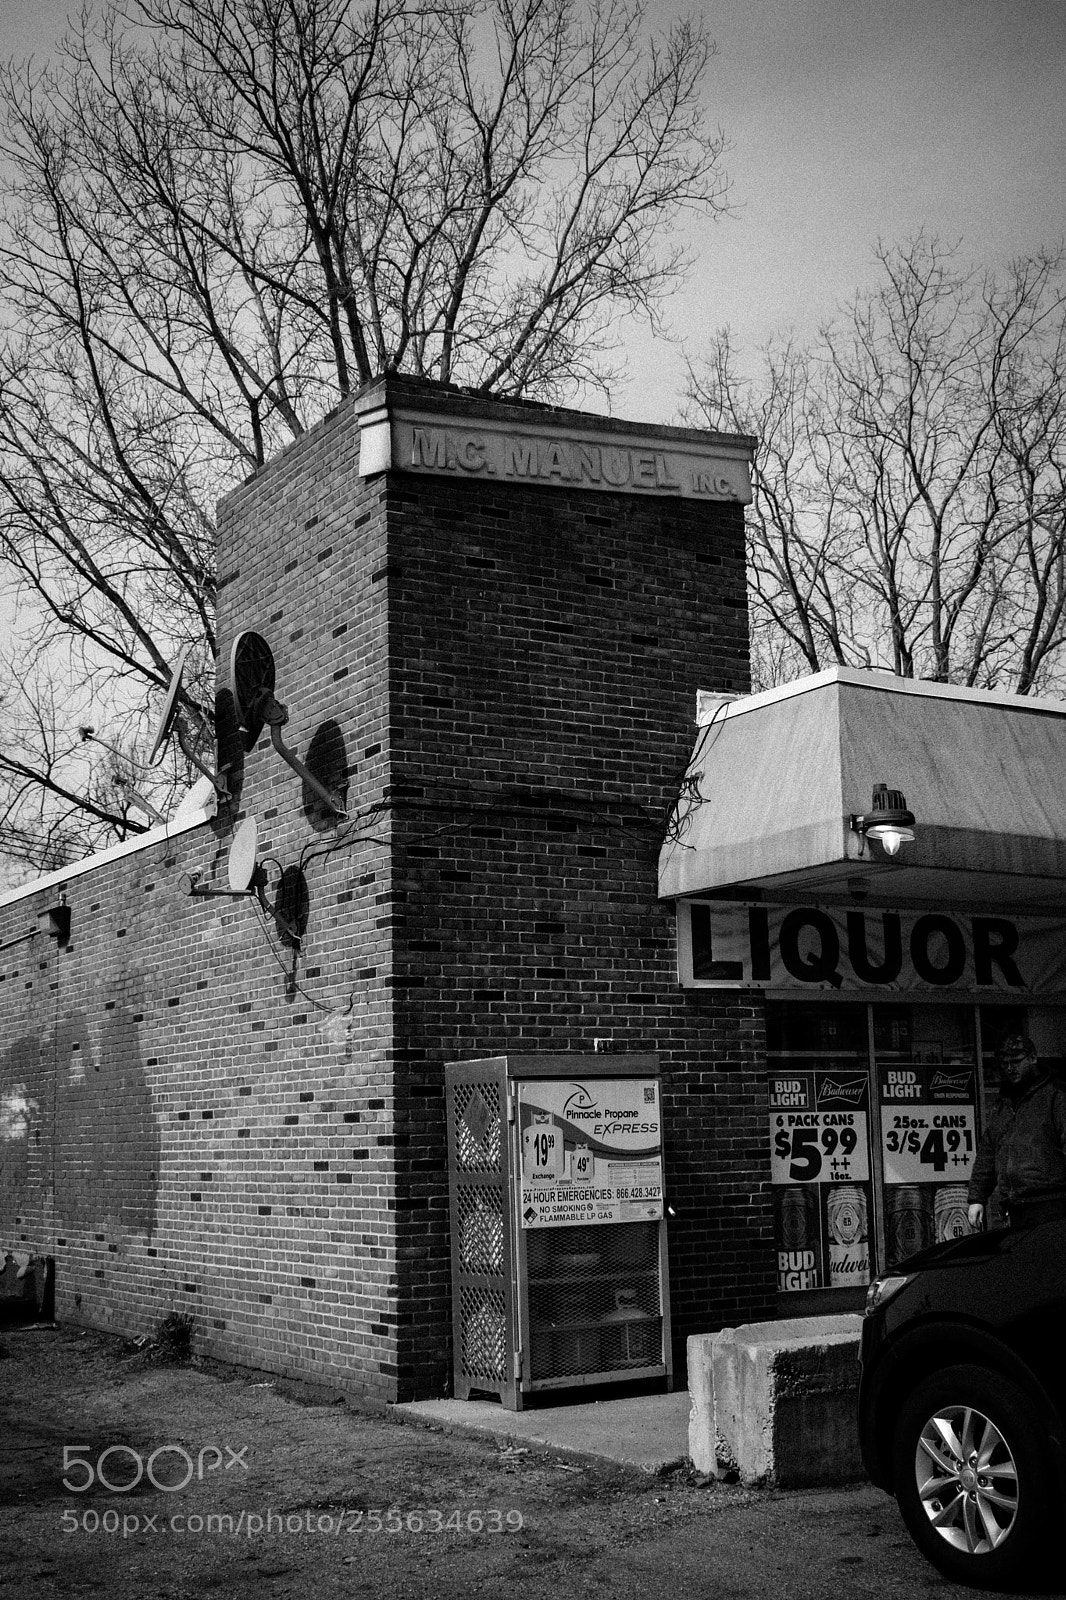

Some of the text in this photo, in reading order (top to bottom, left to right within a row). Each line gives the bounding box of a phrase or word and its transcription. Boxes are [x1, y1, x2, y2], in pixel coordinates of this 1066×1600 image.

[505, 441, 682, 491] MANUEL
[691, 469, 738, 498] INC.
[690, 903, 1029, 990] LIQUOR
[887, 1071, 917, 1085] BUD
[774, 1080, 801, 1093] BUD
[820, 1083, 864, 1097] Budweiser
[883, 1084, 922, 1098] LIGHT
[770, 1093, 807, 1106] LIGHT
[566, 1109, 639, 1120] Pinnacle Propane
[776, 1114, 855, 1127] 6 PACK CANS
[893, 1115, 967, 1129] 25oz. CANS
[593, 1121, 659, 1138] EXPRESS
[532, 1173, 555, 1181] Exchange
[829, 1171, 852, 1181] 16oz.
[523, 1187, 661, 1204] 24 HOUR EMERGENCIES: 866.428.3427
[539, 1205, 551, 1214] NO
[552, 1204, 586, 1213] SMOKING
[539, 1213, 585, 1222] FLAMMABLE
[597, 1212, 613, 1220] GAS
[778, 1250, 815, 1271] BUD
